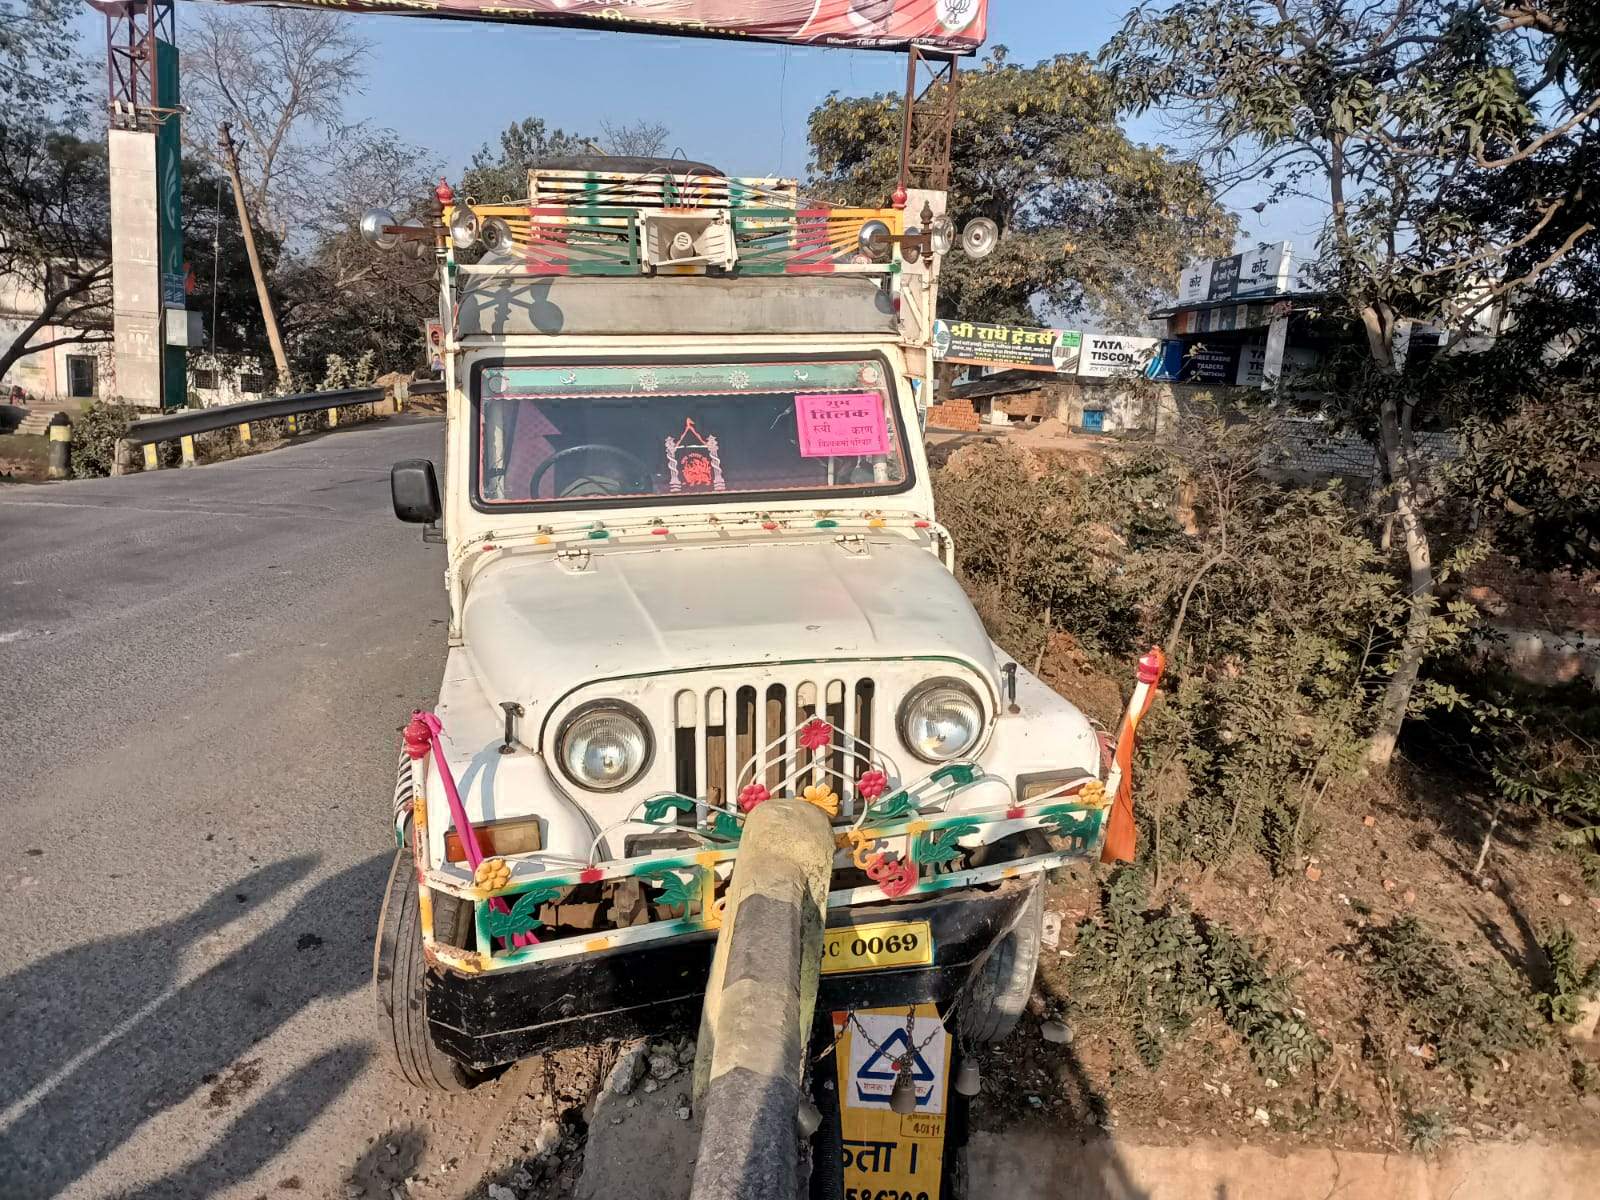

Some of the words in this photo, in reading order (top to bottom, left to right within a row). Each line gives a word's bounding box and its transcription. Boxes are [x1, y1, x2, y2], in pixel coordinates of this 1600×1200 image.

[950, 321, 975, 338] श्री
[1092, 340, 1122, 350] TATA
[1091, 352, 1133, 362] TISCON
[809, 409, 871, 419] तिलक
[851, 933, 918, 956] 0069
